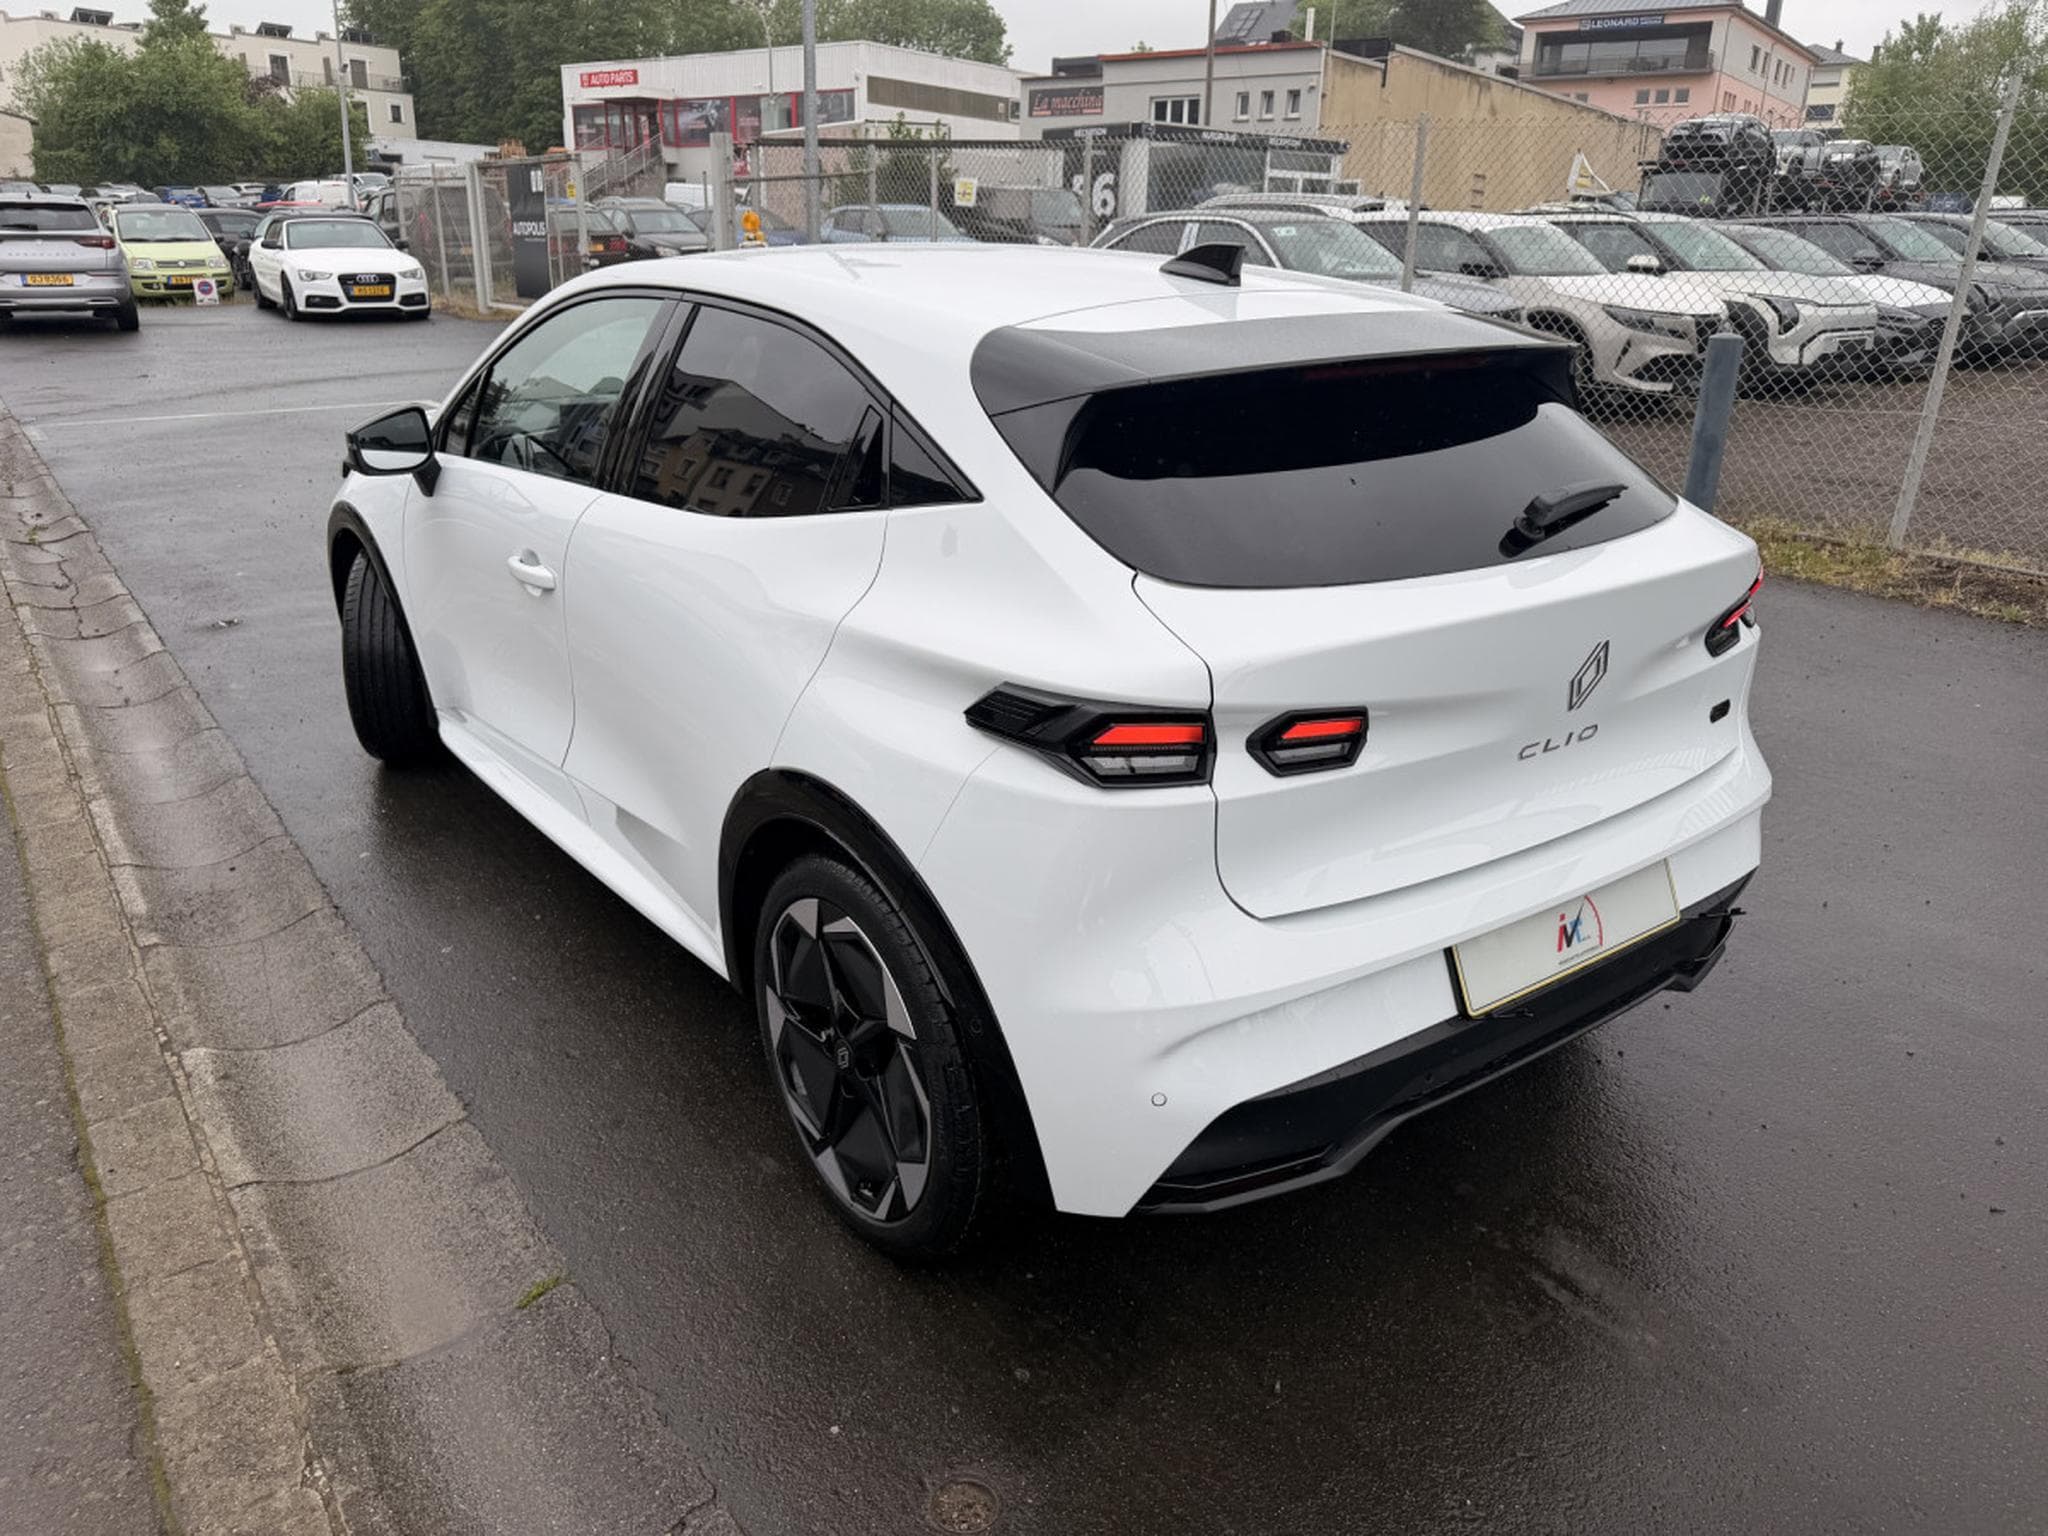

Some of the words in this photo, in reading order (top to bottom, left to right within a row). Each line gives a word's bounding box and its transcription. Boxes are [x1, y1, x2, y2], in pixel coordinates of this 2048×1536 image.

[1591, 17, 1640, 29] LEONARD
[590, 73, 610, 86] AUTO
[610, 70, 634, 84] PARTS
[513, 221, 546, 236] AUTOPOLIS
[1517, 724, 1598, 761] CLIO
